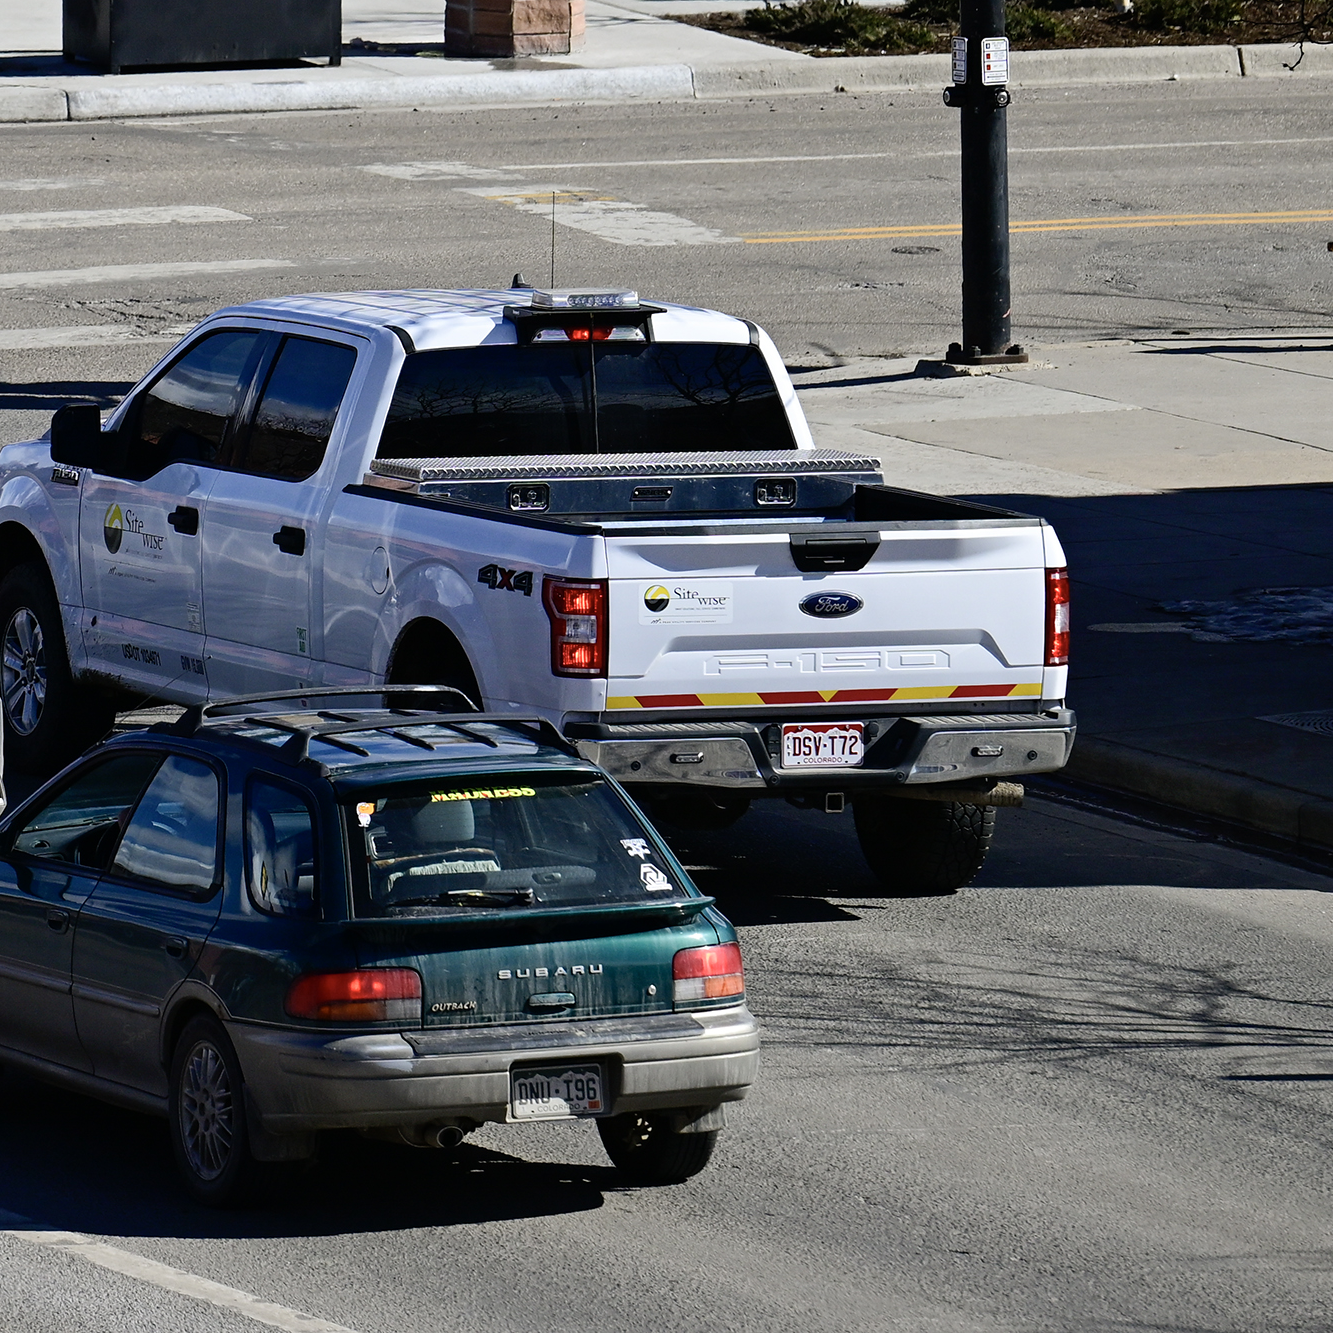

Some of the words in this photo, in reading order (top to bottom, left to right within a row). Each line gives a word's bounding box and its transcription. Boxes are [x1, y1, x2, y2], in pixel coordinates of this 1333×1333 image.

[125, 509, 144, 534] Site
[673, 587, 699, 599] Site
[815, 596, 849, 613] Ford
[704, 650, 951, 676] F-150
[498, 964, 603, 979] SUBARU
[431, 1001, 478, 1012] OUTBACK
[537, 1103, 581, 1113] COLORADO
